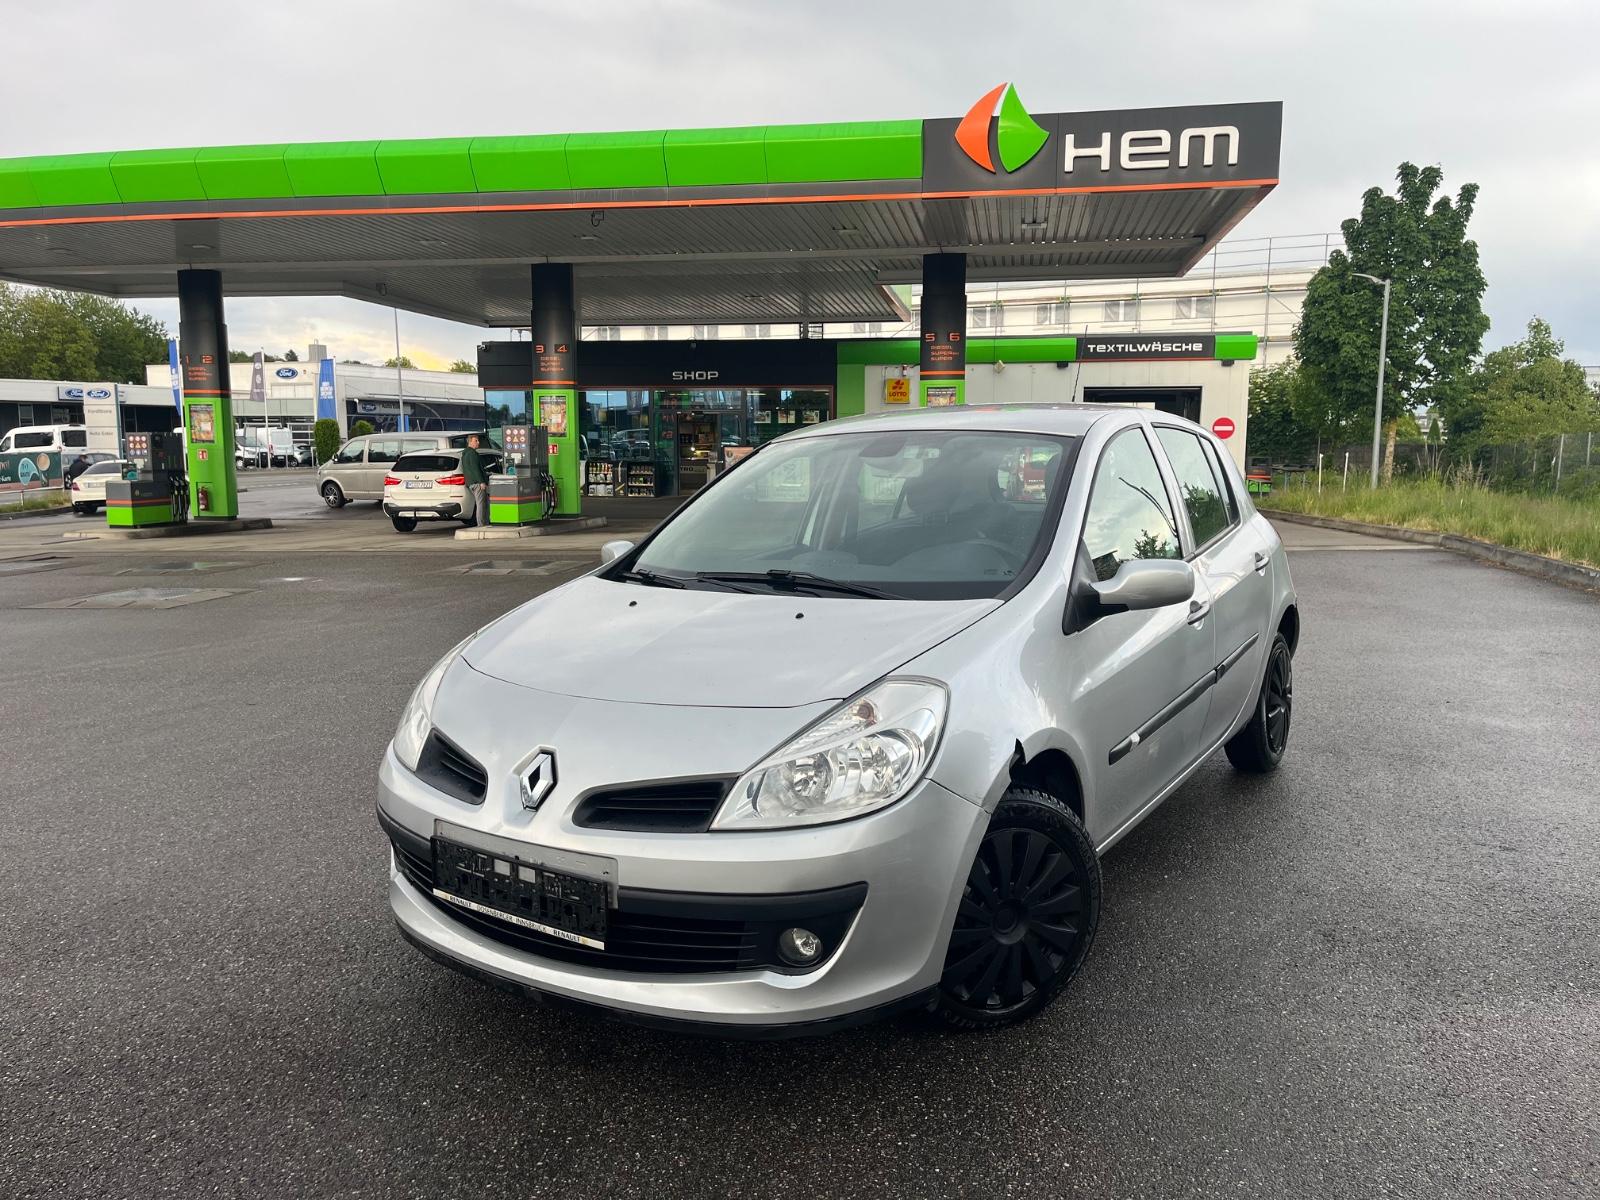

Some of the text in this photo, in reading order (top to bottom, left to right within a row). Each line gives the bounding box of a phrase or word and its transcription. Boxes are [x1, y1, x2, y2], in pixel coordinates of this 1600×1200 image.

[1064, 125, 1240, 173] HEM
[925, 332, 960, 342] 5 6
[535, 344, 568, 353] 3 4
[1087, 341, 1203, 353] TEXTILWÄSCHE
[672, 371, 719, 381] SHOP
[449, 895, 472, 908] RENAULT
[553, 928, 581, 942] RENAULT
